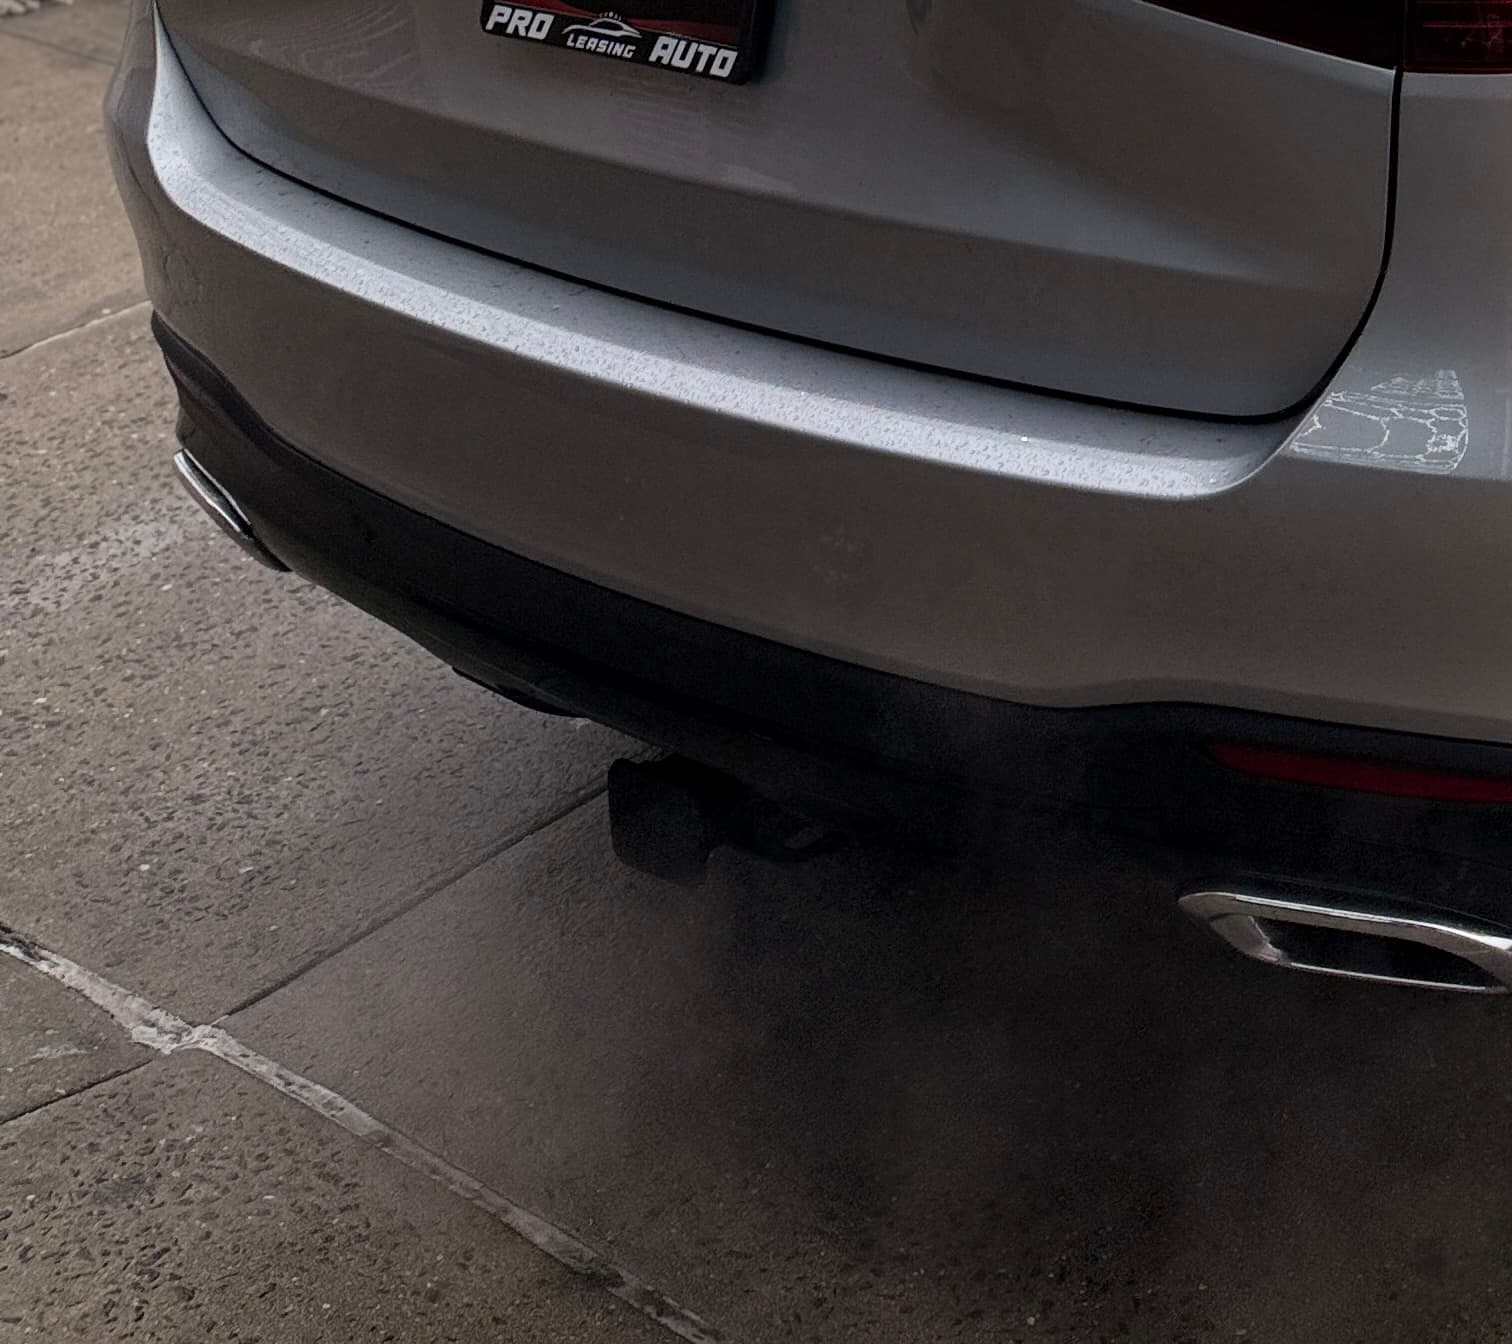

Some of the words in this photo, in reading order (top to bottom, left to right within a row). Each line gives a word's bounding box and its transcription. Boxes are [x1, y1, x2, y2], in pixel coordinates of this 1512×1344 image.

[485, 5, 554, 40] PRO
[566, 33, 637, 58] LEASING
[649, 36, 737, 77] AUTO
